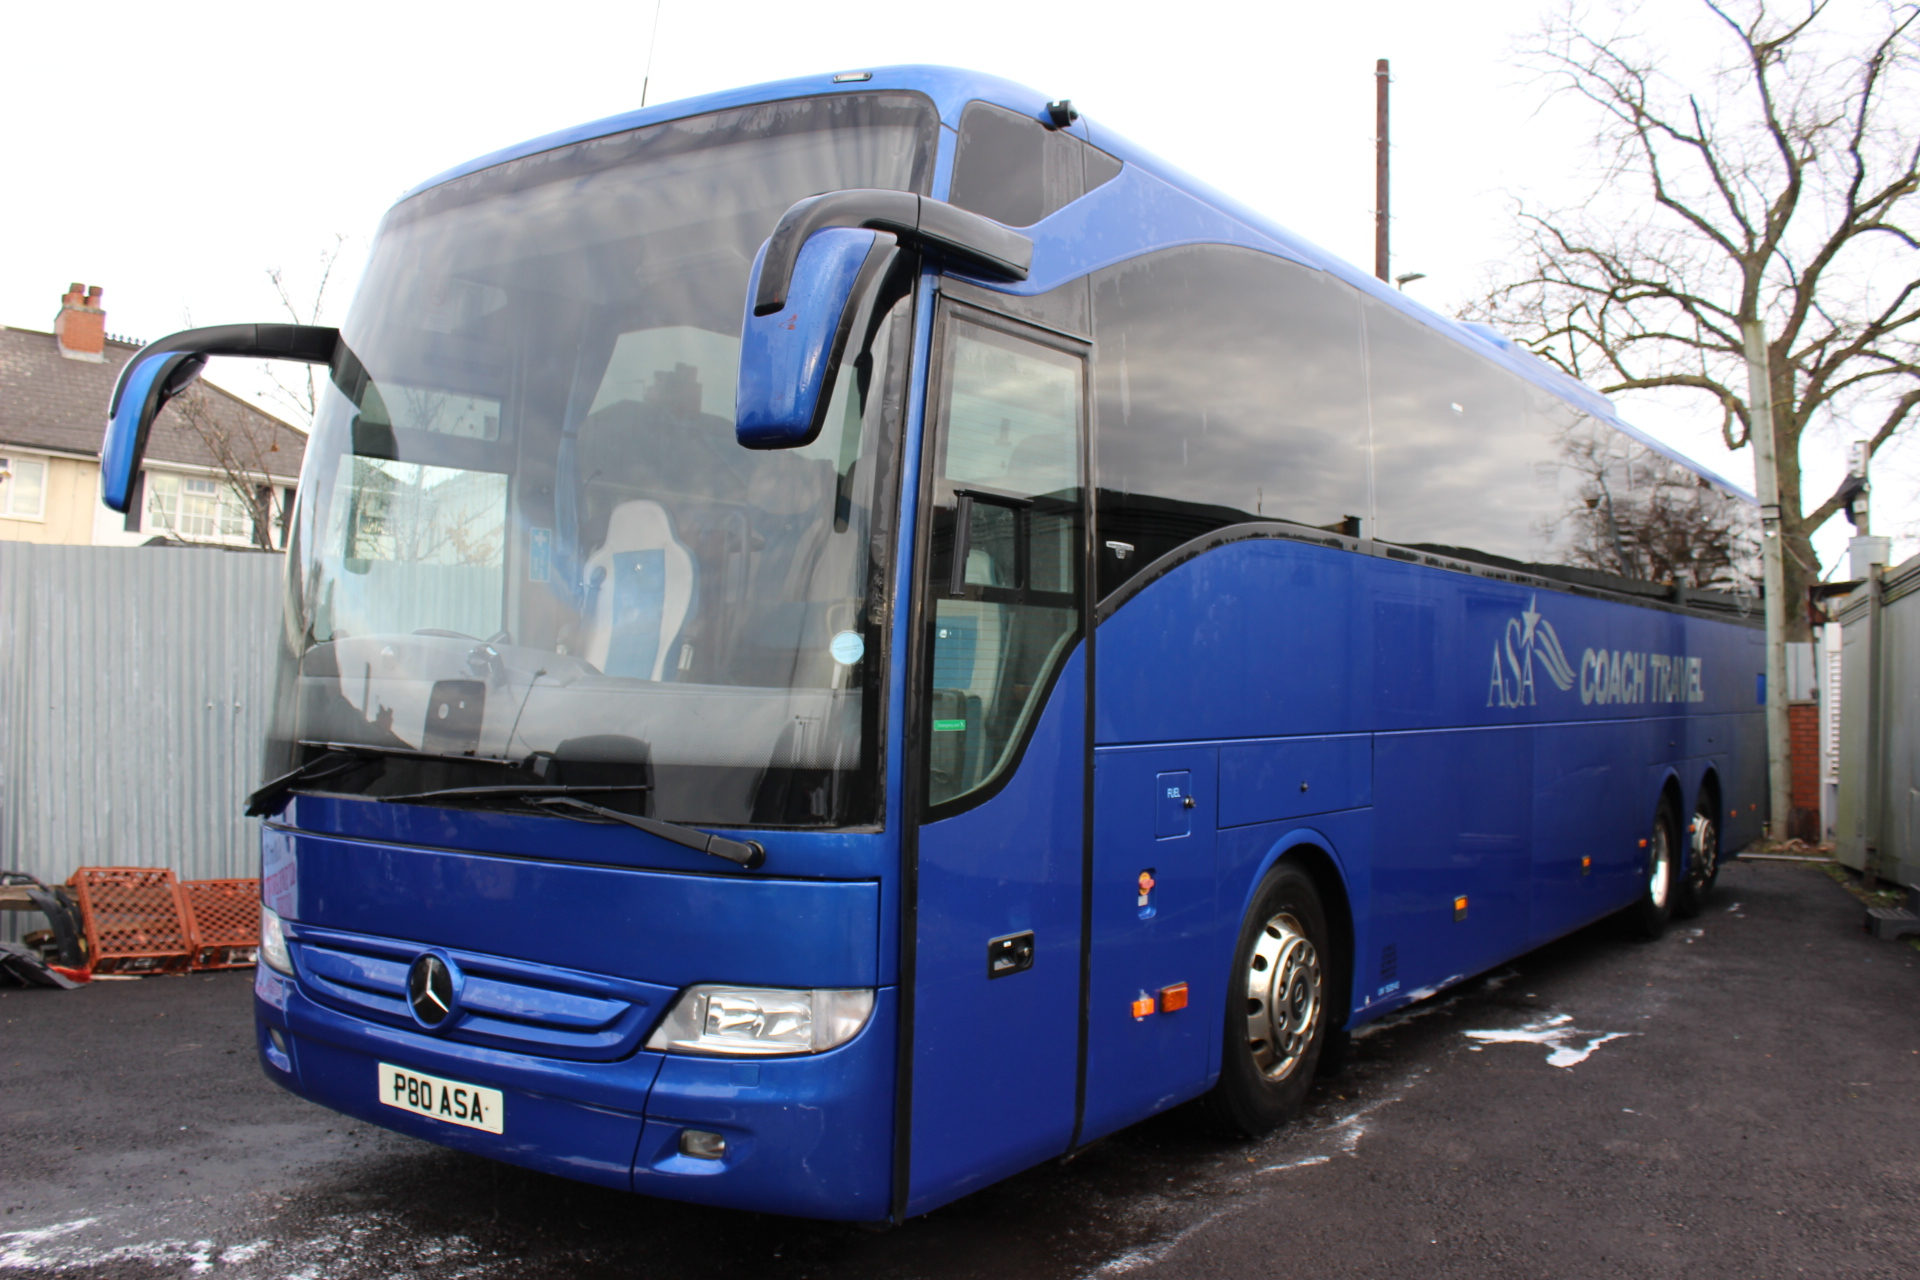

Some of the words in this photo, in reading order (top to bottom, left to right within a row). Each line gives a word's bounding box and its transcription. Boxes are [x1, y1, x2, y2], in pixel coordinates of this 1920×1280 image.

[1486, 617, 1537, 708] ASA
[1580, 648, 1647, 705] COACH
[1651, 654, 1704, 703] TRAVEL
[1167, 787, 1181, 798] FUEL
[394, 1072, 432, 1111] P80
[440, 1085, 484, 1123] ASA
